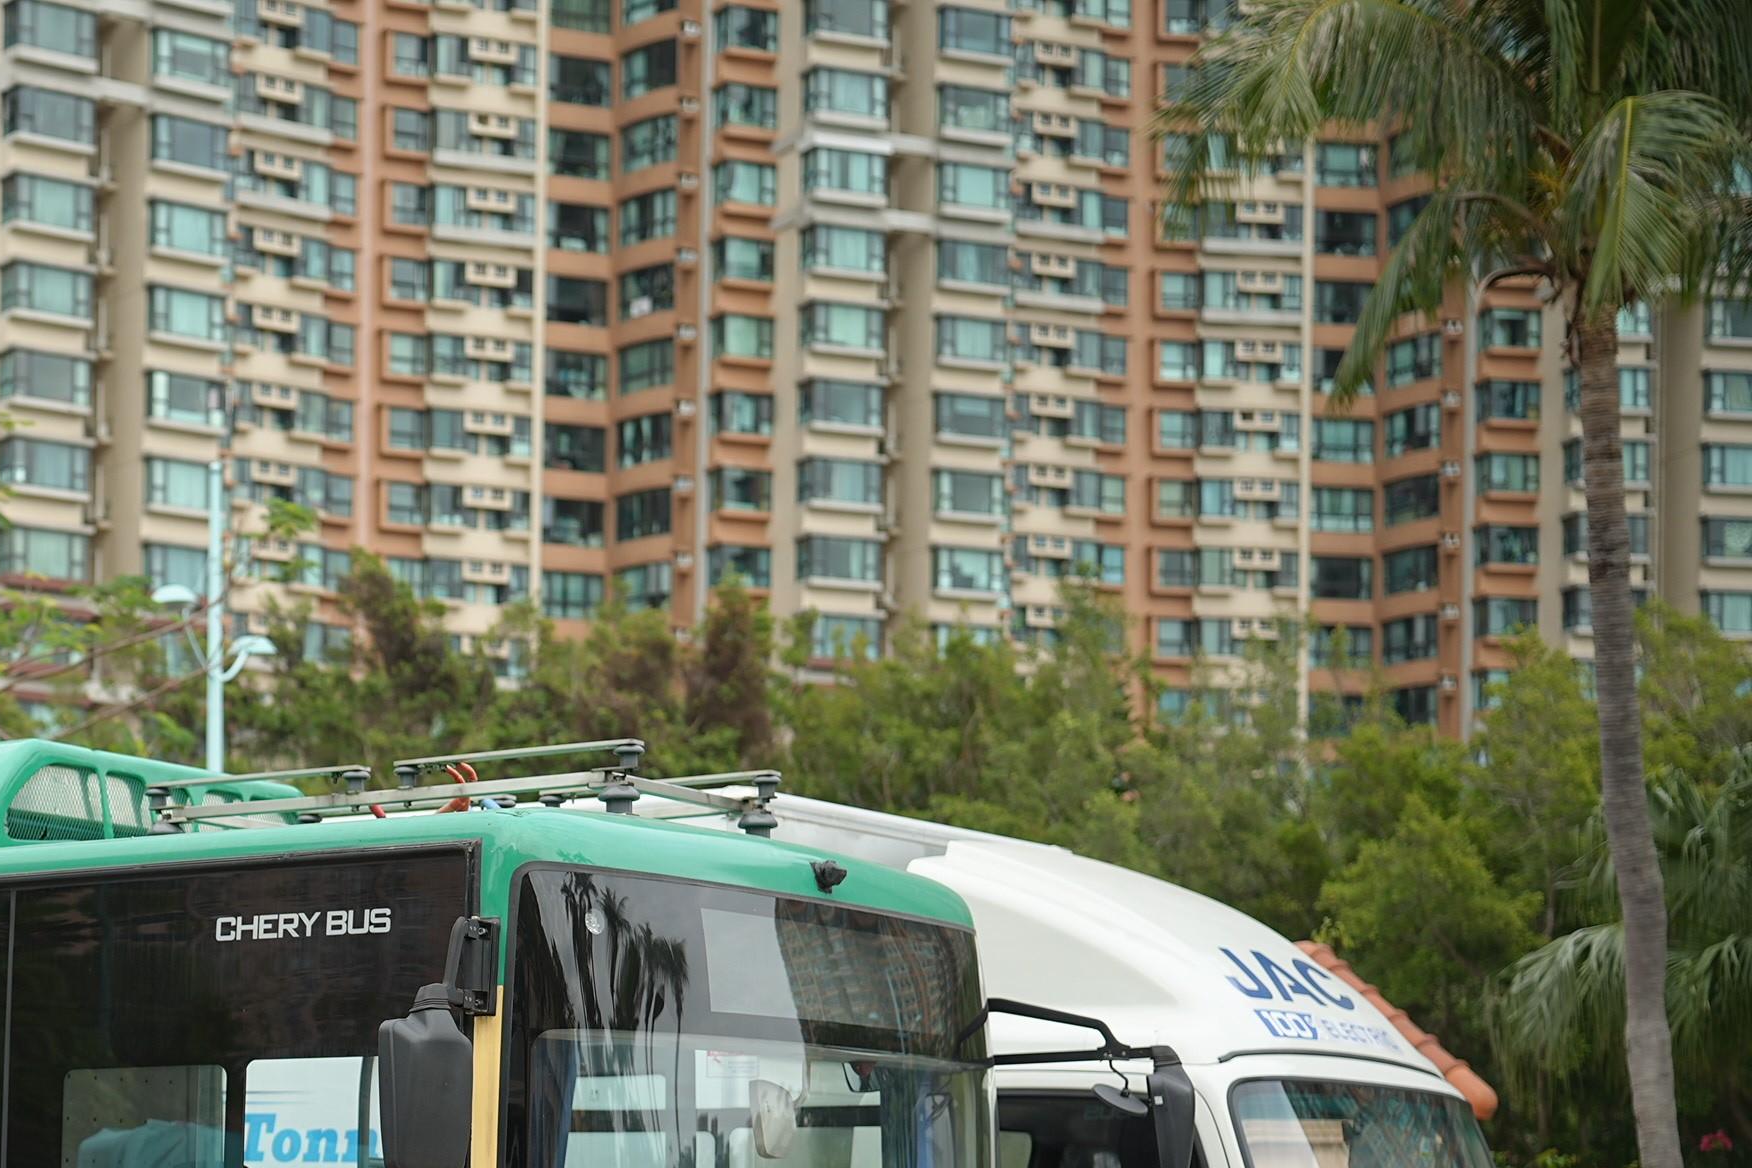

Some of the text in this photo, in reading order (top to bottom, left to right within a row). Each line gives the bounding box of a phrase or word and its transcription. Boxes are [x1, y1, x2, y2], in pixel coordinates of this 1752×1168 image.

[215, 907, 392, 942] CHERY BUS
[1218, 946, 1355, 1011] JAC
